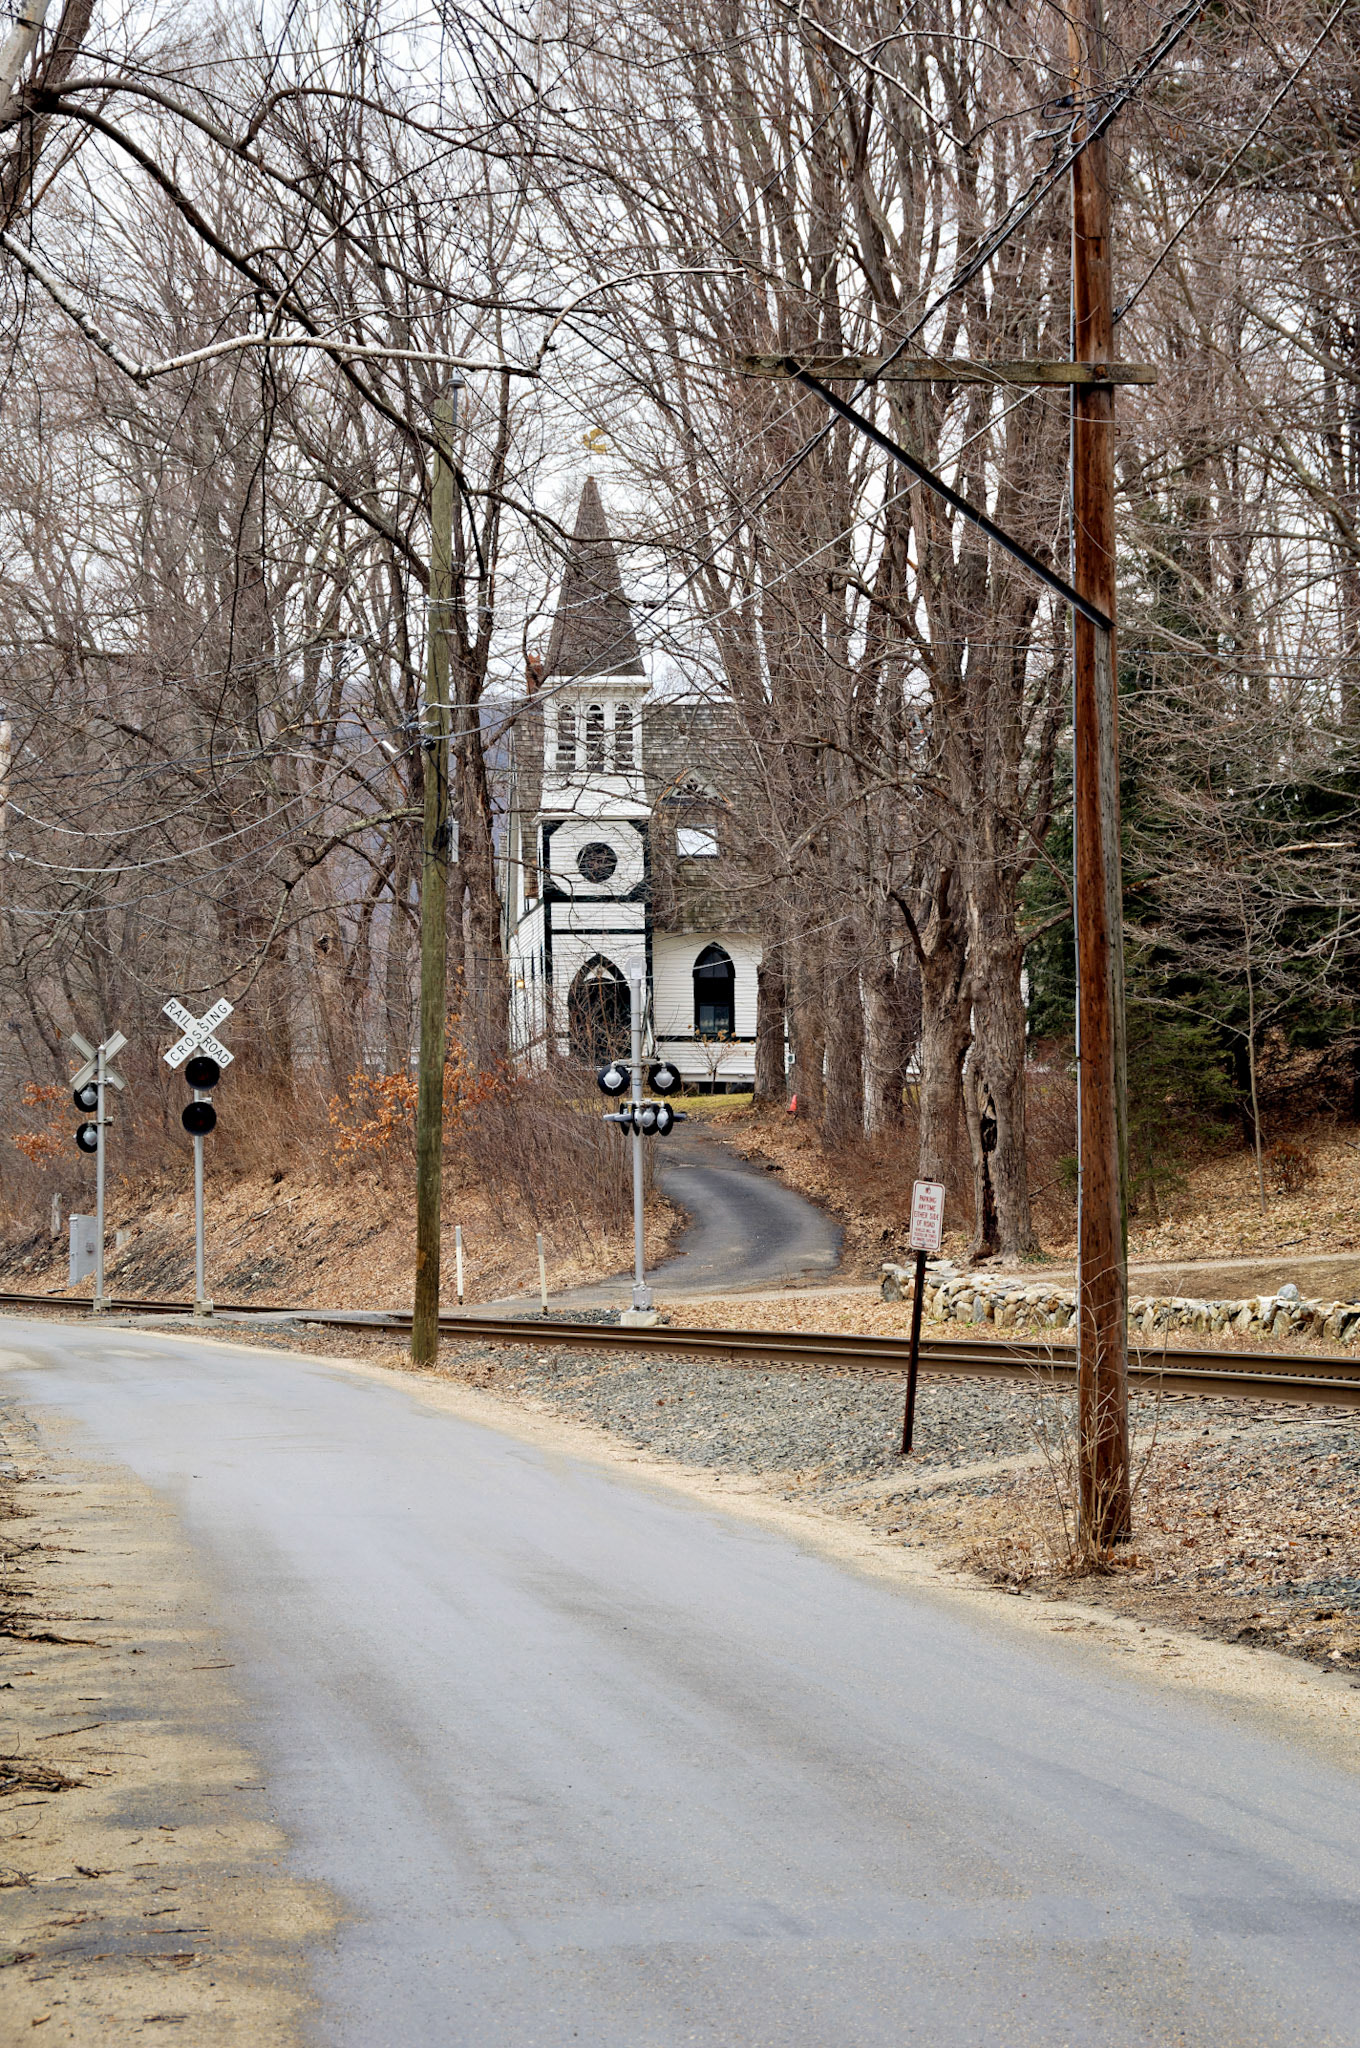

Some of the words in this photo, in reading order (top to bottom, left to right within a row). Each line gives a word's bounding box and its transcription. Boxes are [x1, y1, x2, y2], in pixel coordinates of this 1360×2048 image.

[166, 1001, 191, 1029] RAIL
[202, 1036, 230, 1064] ROAD
[170, 1004, 228, 1062] CROSSING
